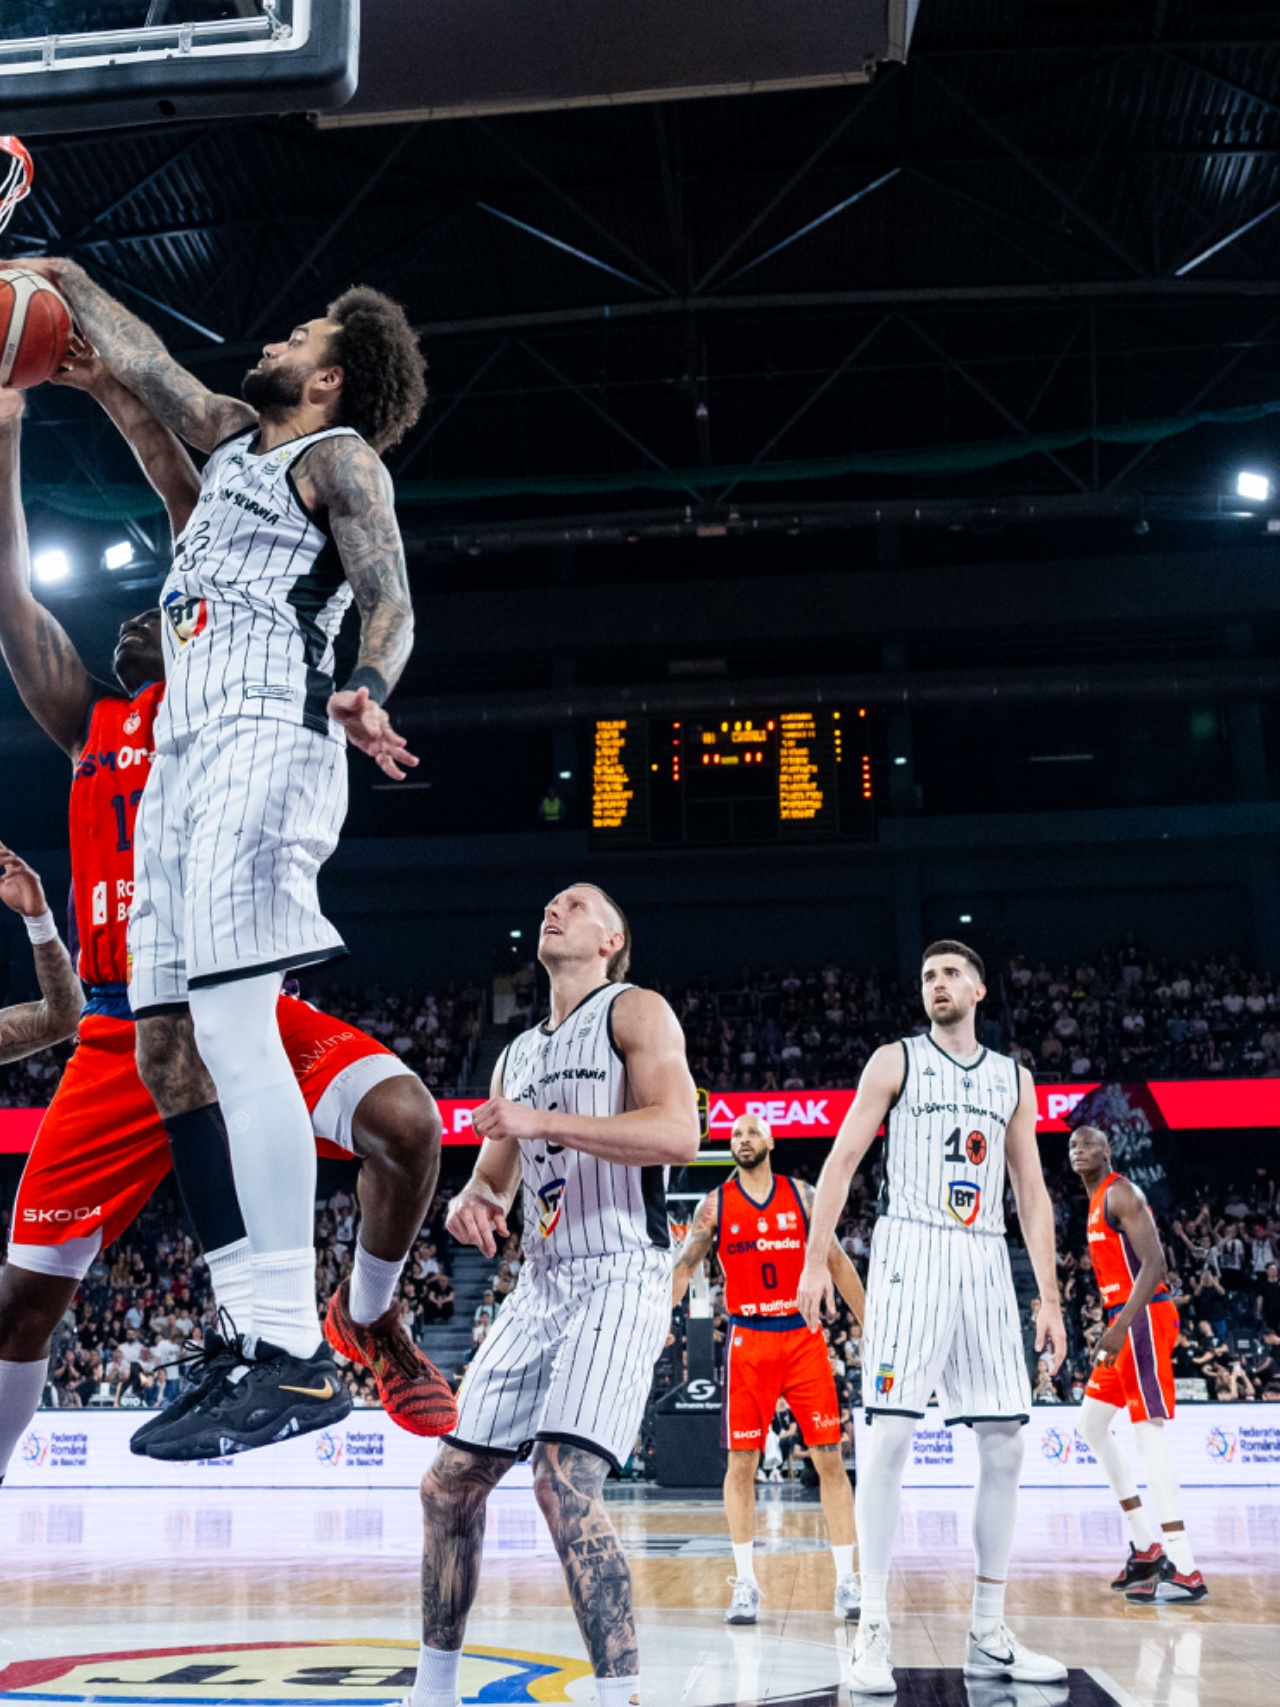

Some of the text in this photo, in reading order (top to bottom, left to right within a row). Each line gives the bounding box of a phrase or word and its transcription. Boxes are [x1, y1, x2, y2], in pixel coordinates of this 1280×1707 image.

[746, 1099, 830, 1125] PEAK
[954, 1189, 975, 1207] BT
[761, 1263, 778, 1289] 0
